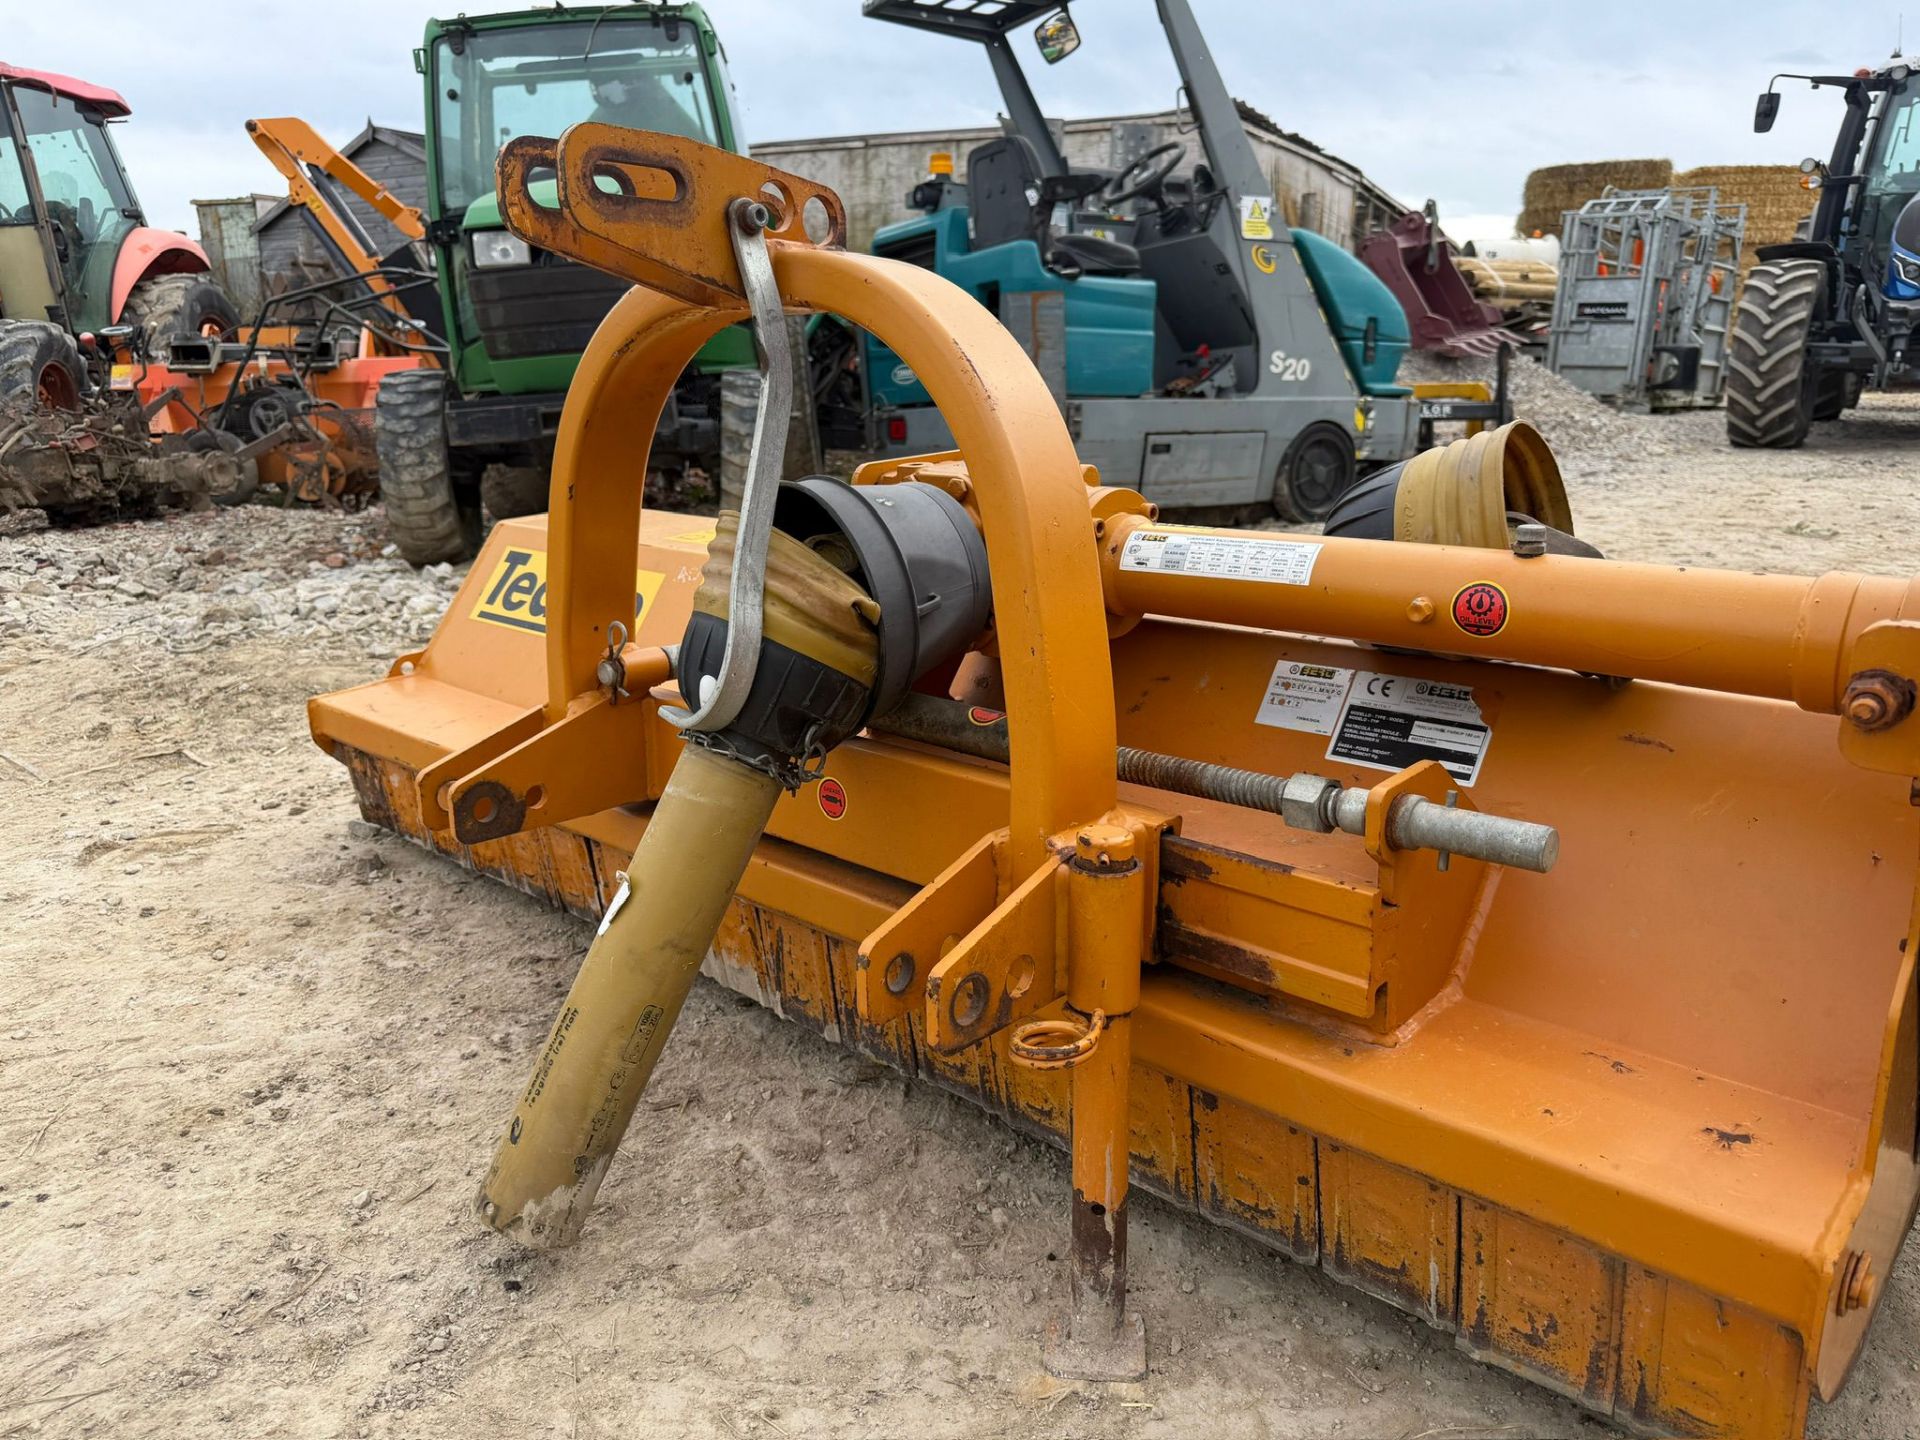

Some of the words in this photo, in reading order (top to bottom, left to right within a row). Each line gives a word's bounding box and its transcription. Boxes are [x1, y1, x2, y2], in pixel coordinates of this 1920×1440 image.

[1270, 350, 1310, 381] S20
[1474, 616, 1497, 626] LEVEL
[1367, 677, 1395, 698] CE
[552, 1034, 566, 1055] (re)
